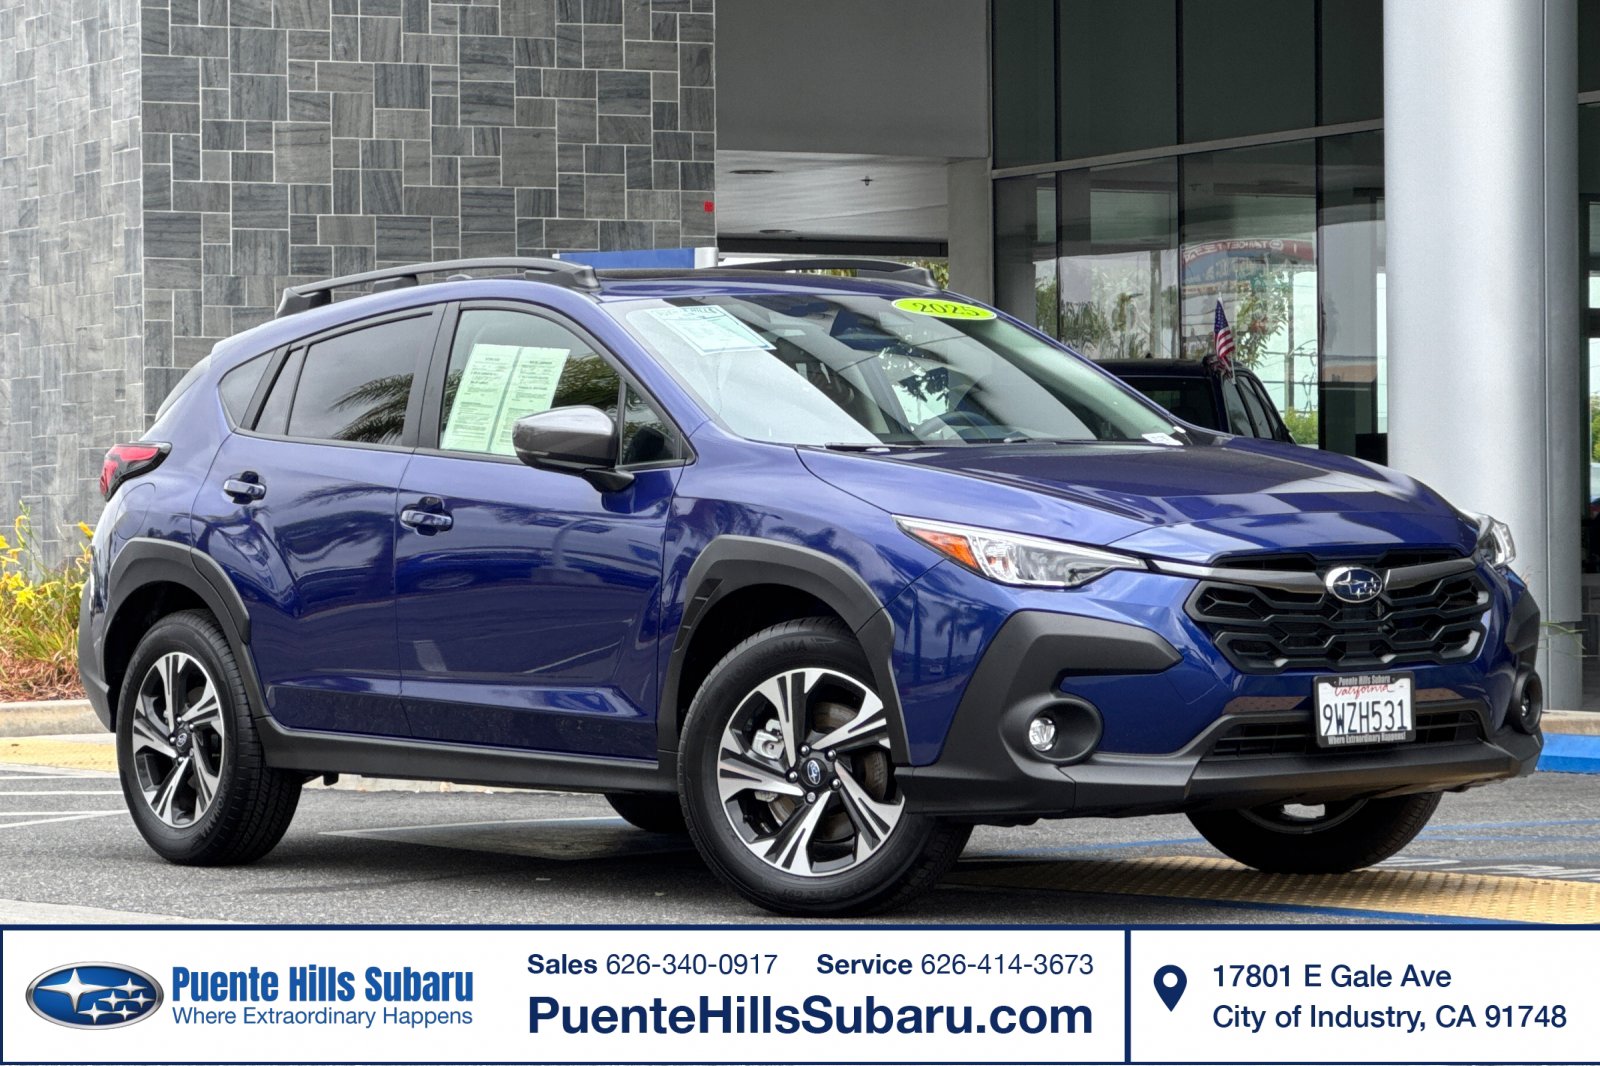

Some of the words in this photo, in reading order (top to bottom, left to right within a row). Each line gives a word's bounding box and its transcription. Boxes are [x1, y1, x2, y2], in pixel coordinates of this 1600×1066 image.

[912, 302, 980, 317] 2025
[1338, 676, 1358, 686] Puente
[1358, 675, 1371, 685] Hills
[1371, 674, 1391, 684] Subaru
[1334, 684, 1395, 699] California
[1323, 699, 1407, 735] 9WZH531
[1328, 735, 1346, 745] Where
[1346, 732, 1381, 743] Extraordinary
